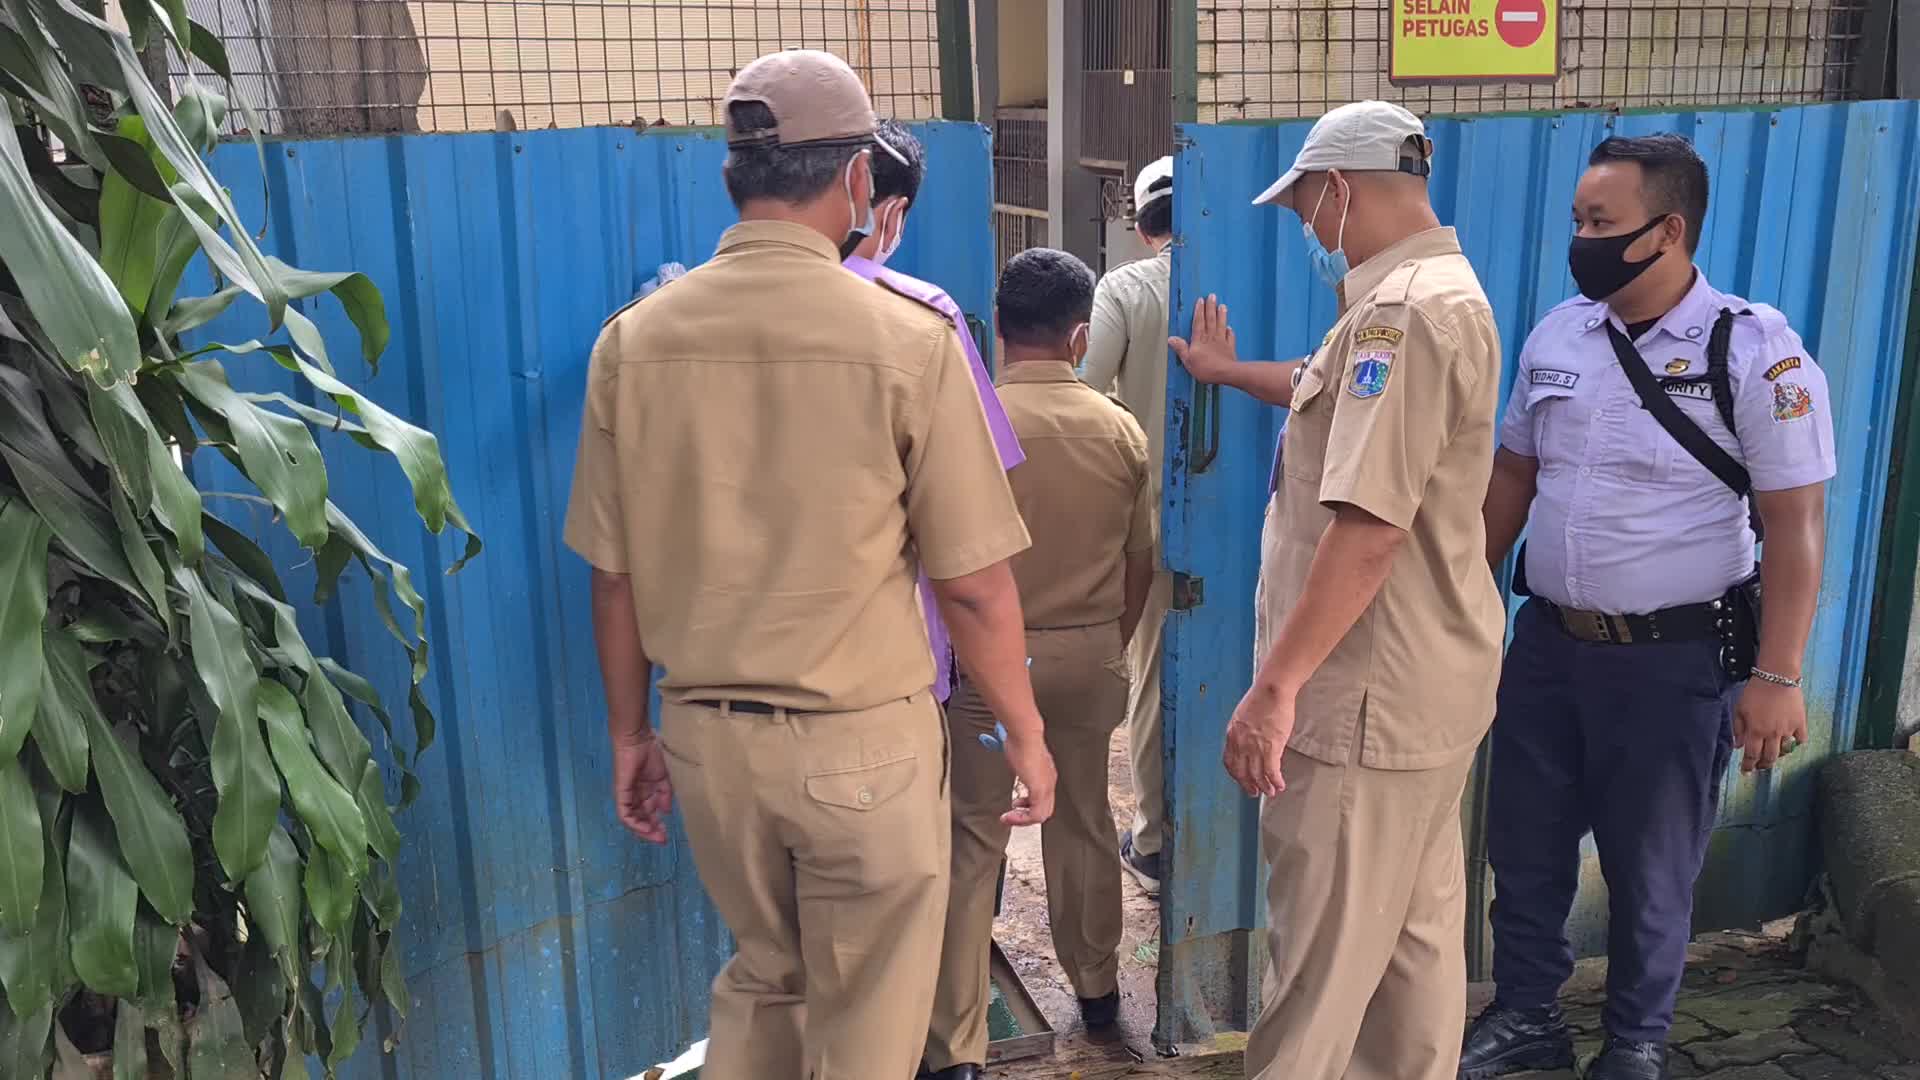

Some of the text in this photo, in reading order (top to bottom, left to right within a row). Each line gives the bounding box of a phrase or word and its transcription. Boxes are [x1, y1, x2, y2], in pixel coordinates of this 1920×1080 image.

[1403, 0, 1471, 14] SELAIN
[1403, 19, 1489, 37] PETUGAS
[1768, 358, 1800, 380] JAKARTA
[1665, 382, 1708, 396] URITY
